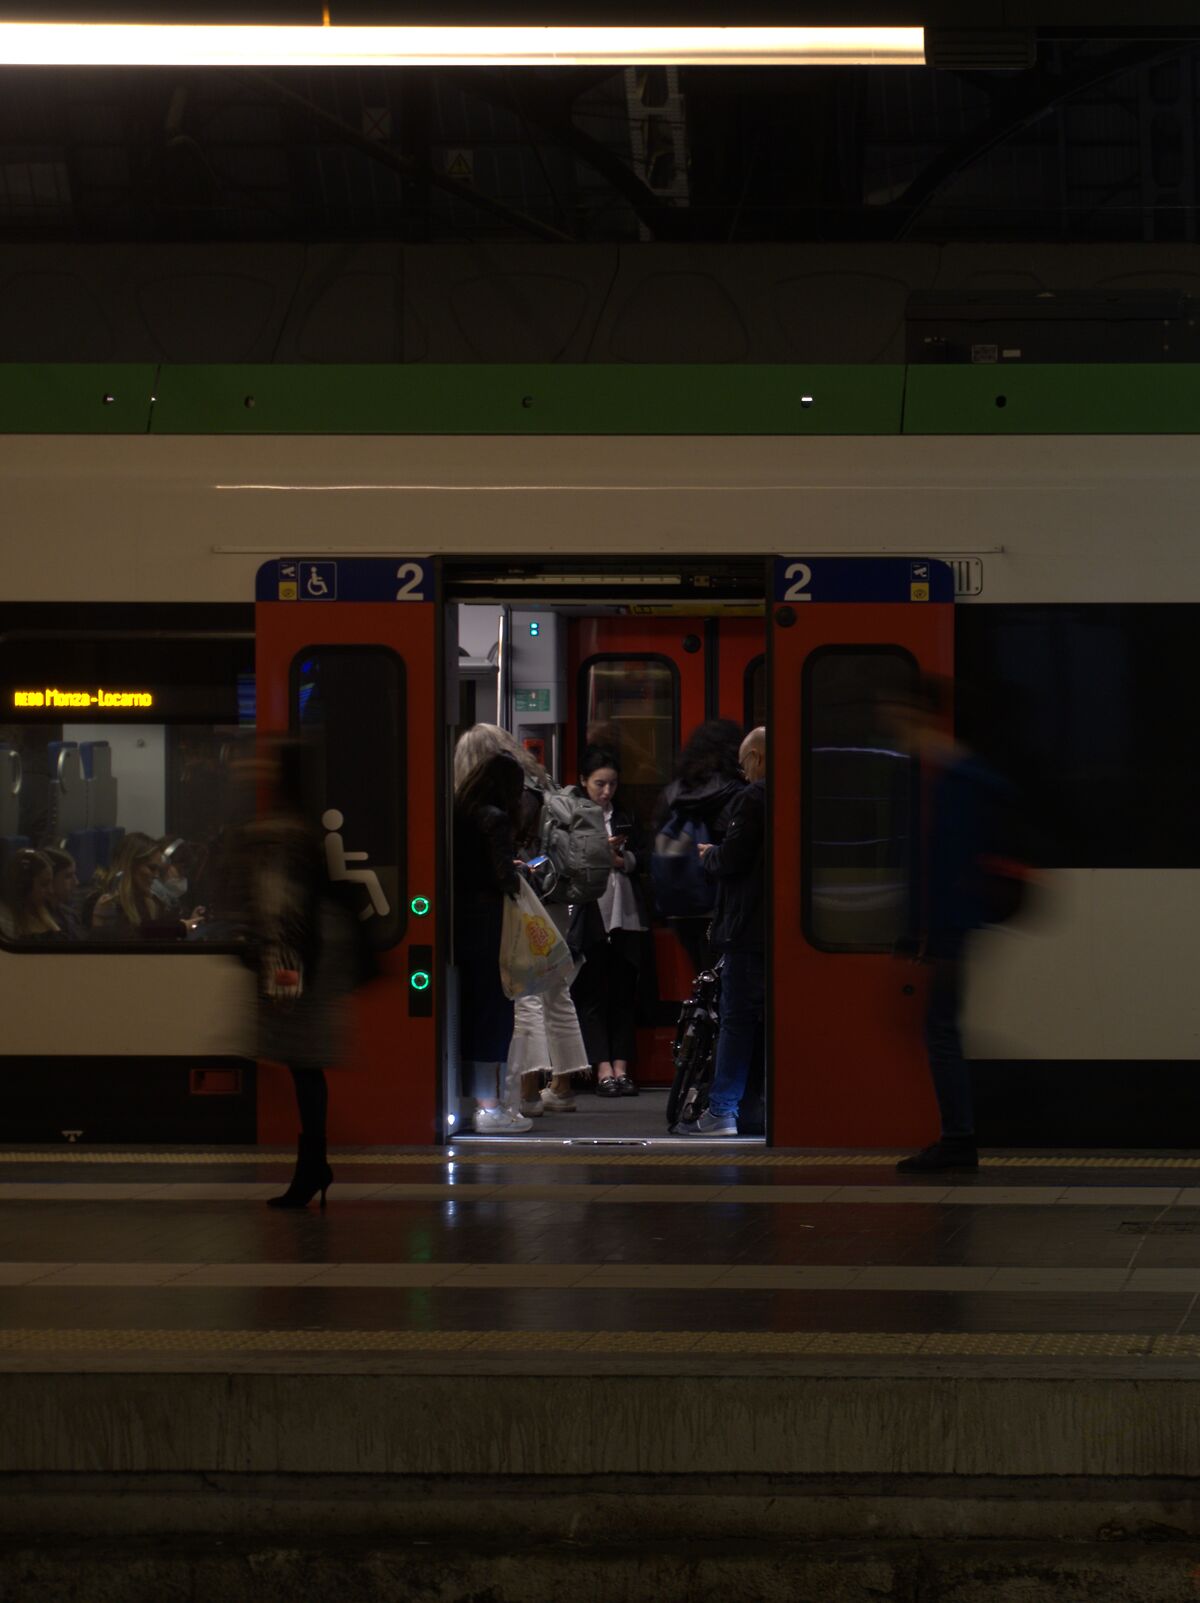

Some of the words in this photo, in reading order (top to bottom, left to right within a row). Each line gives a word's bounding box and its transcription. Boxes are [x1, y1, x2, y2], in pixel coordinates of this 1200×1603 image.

[396, 562, 424, 601] 2
[784, 562, 812, 601] 2
[45, 688, 152, 707] Monza-Locarno
